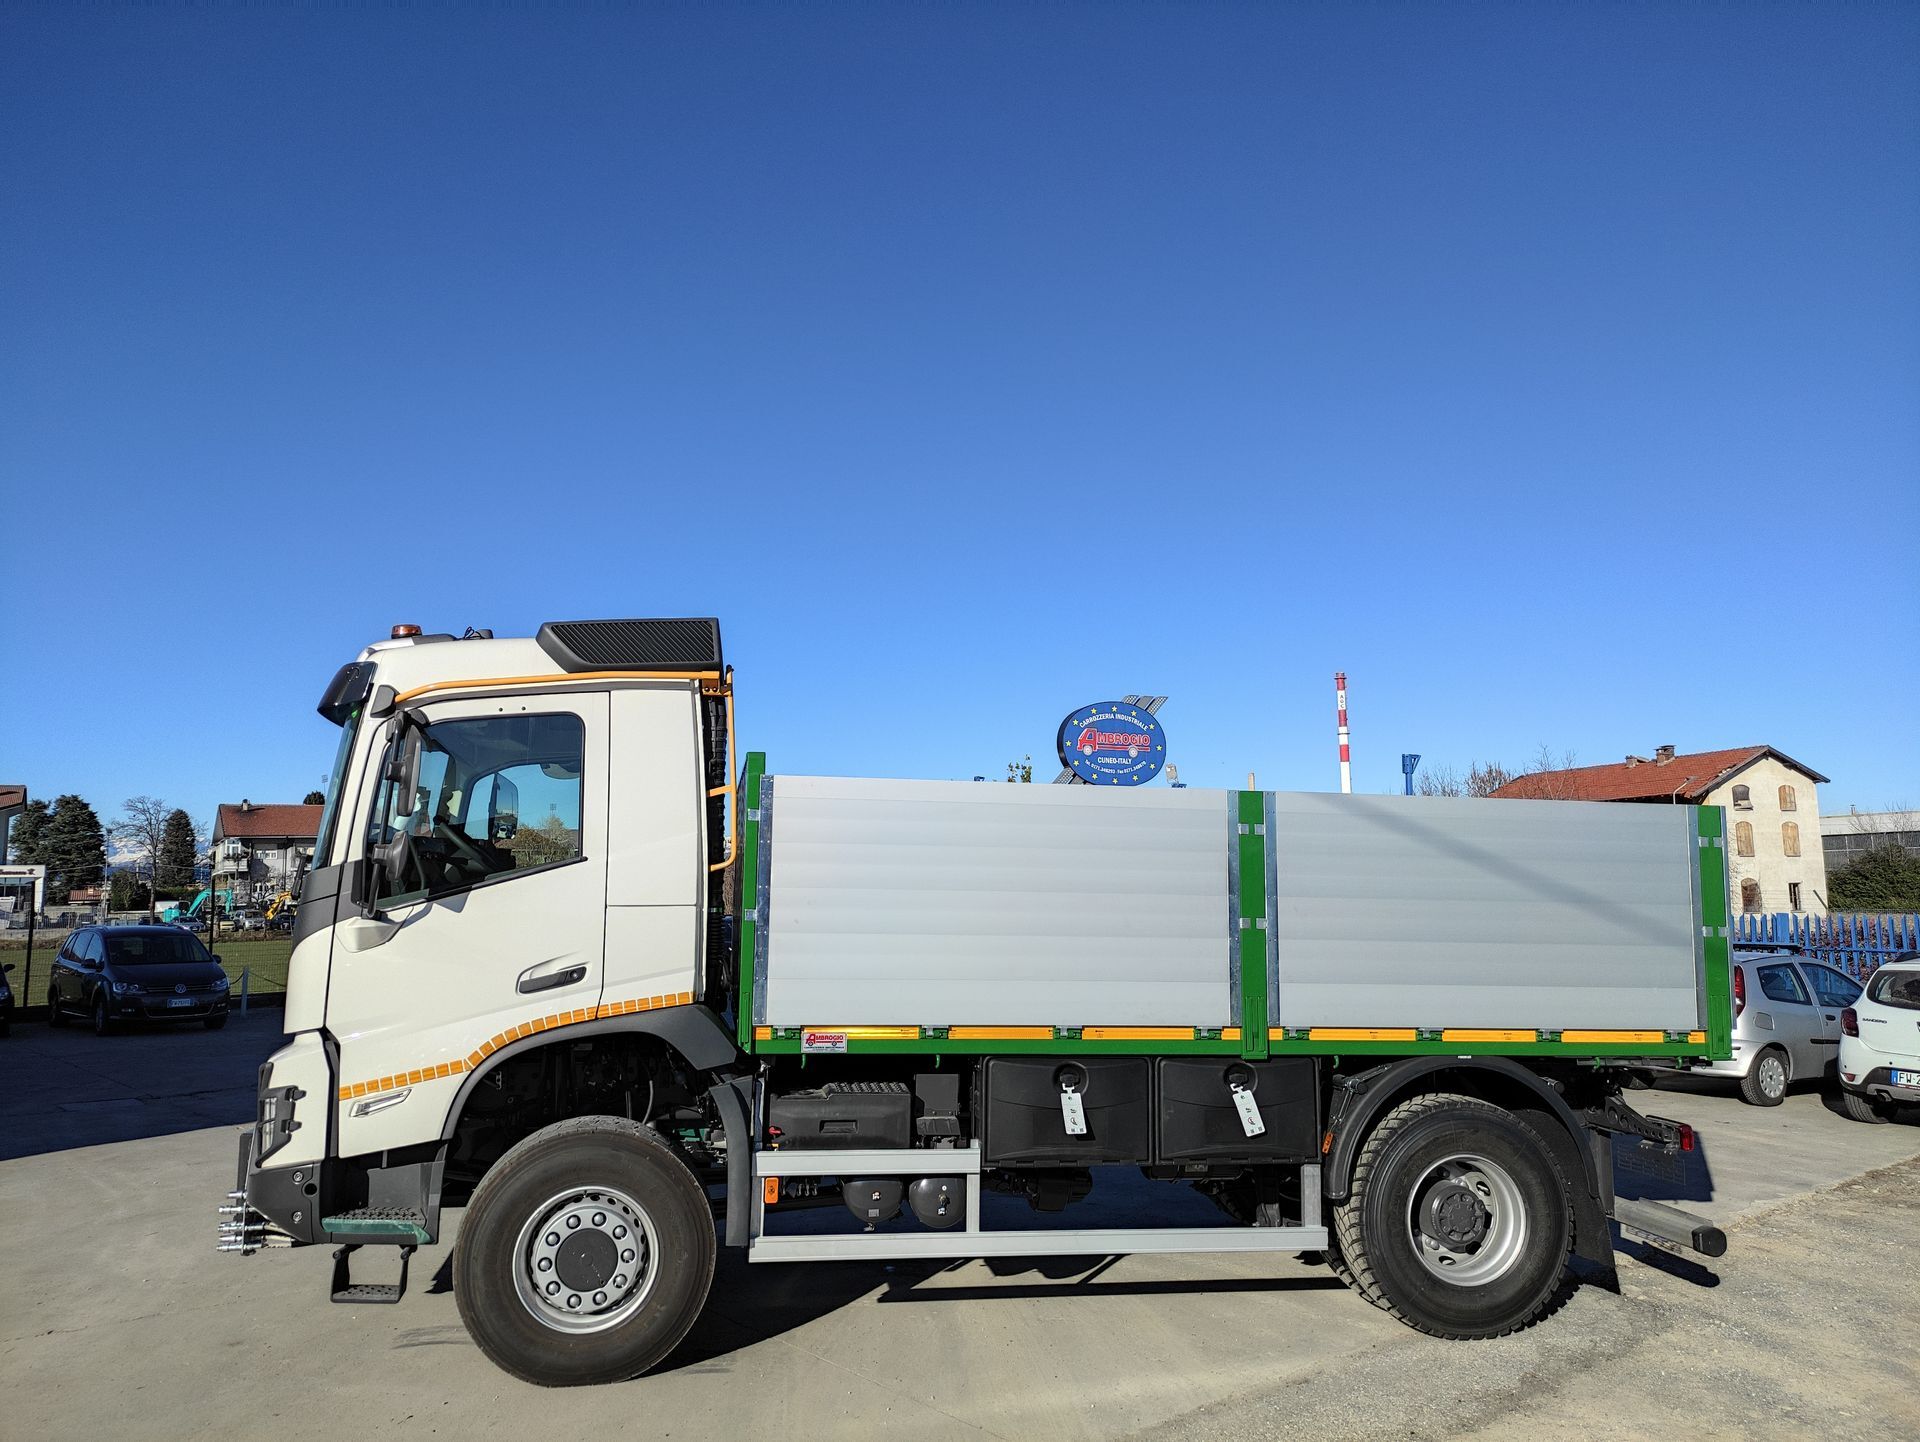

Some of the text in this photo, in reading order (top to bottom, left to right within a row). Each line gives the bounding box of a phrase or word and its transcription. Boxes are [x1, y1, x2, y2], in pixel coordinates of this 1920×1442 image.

[1079, 713, 1149, 732] CARROZZERIA INDUSTRIALE
[1077, 728, 1151, 752] AMBROGIO
